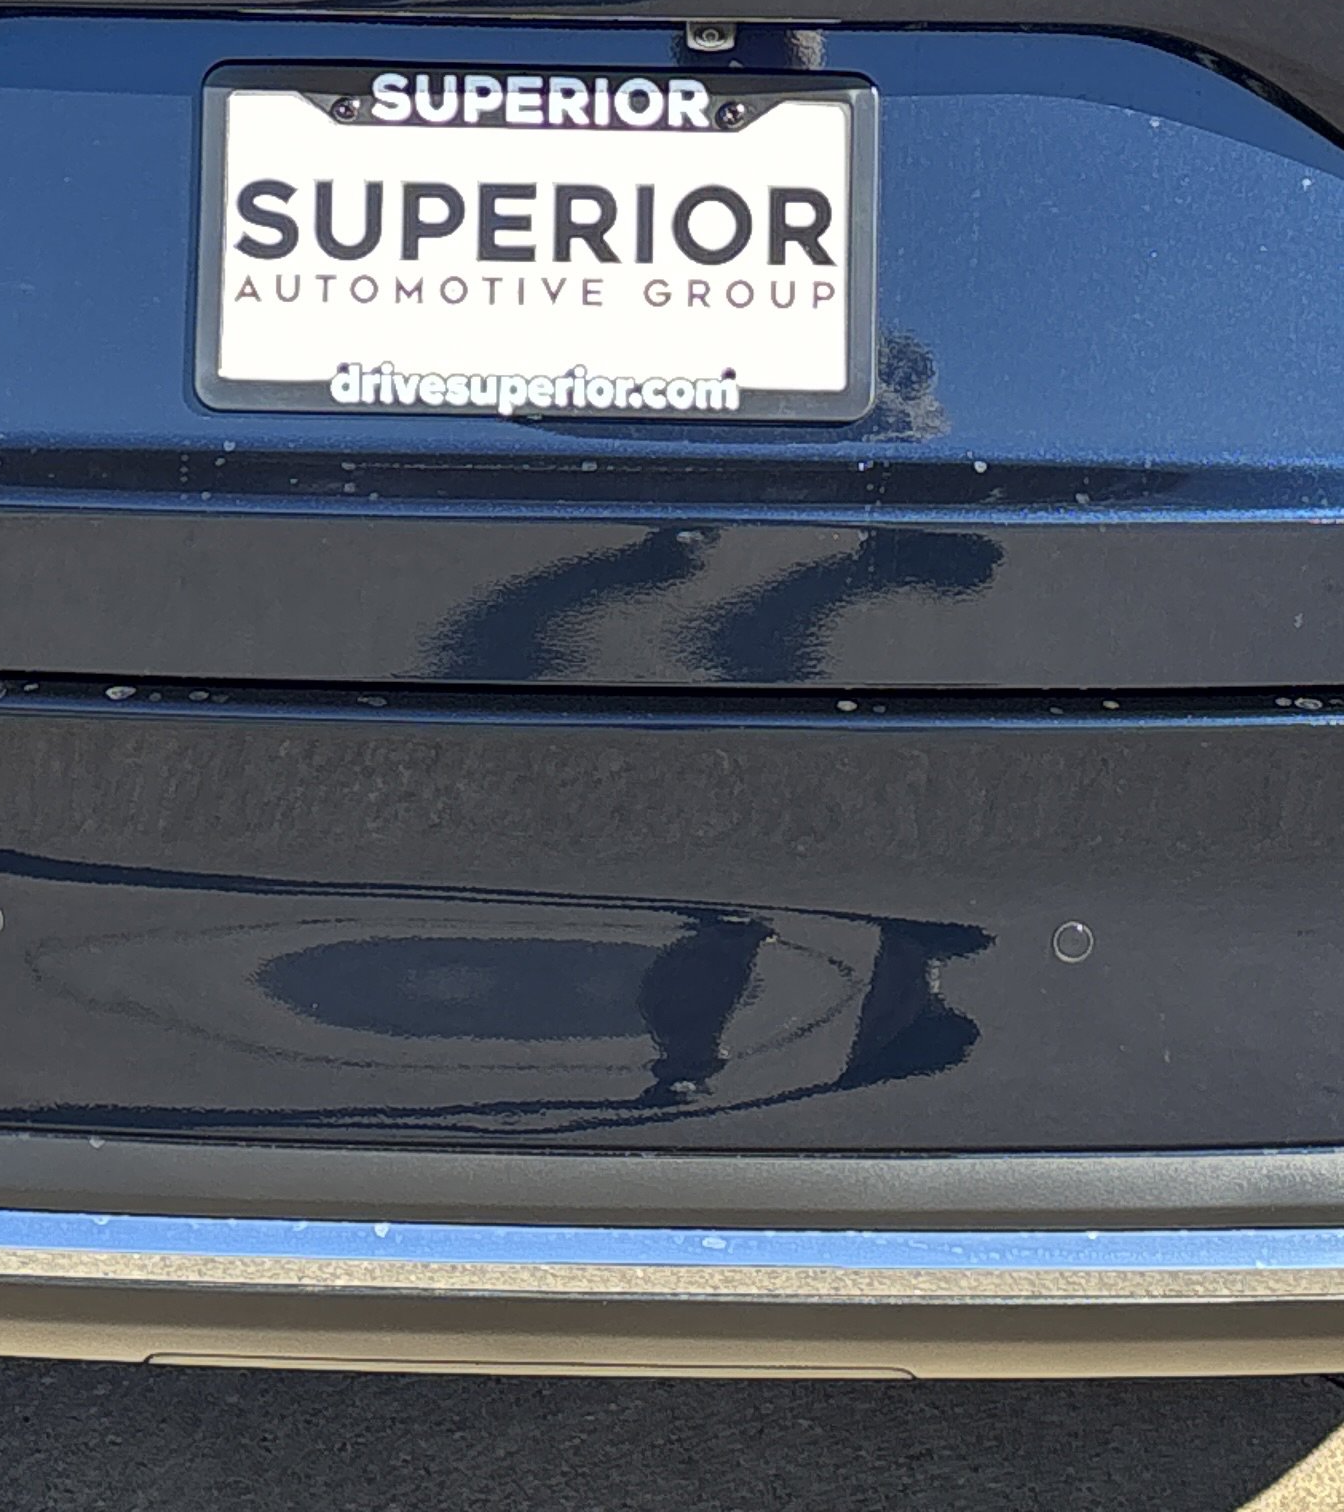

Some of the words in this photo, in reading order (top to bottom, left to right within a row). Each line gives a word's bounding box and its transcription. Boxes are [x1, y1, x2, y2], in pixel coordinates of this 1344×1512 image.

[371, 73, 712, 127] SUPERIOR
[233, 179, 837, 266] SUPERIOR
[234, 274, 604, 307] AUTOMOTIVE
[644, 279, 836, 309] GROUP
[330, 362, 741, 416] drivesuperior.com
